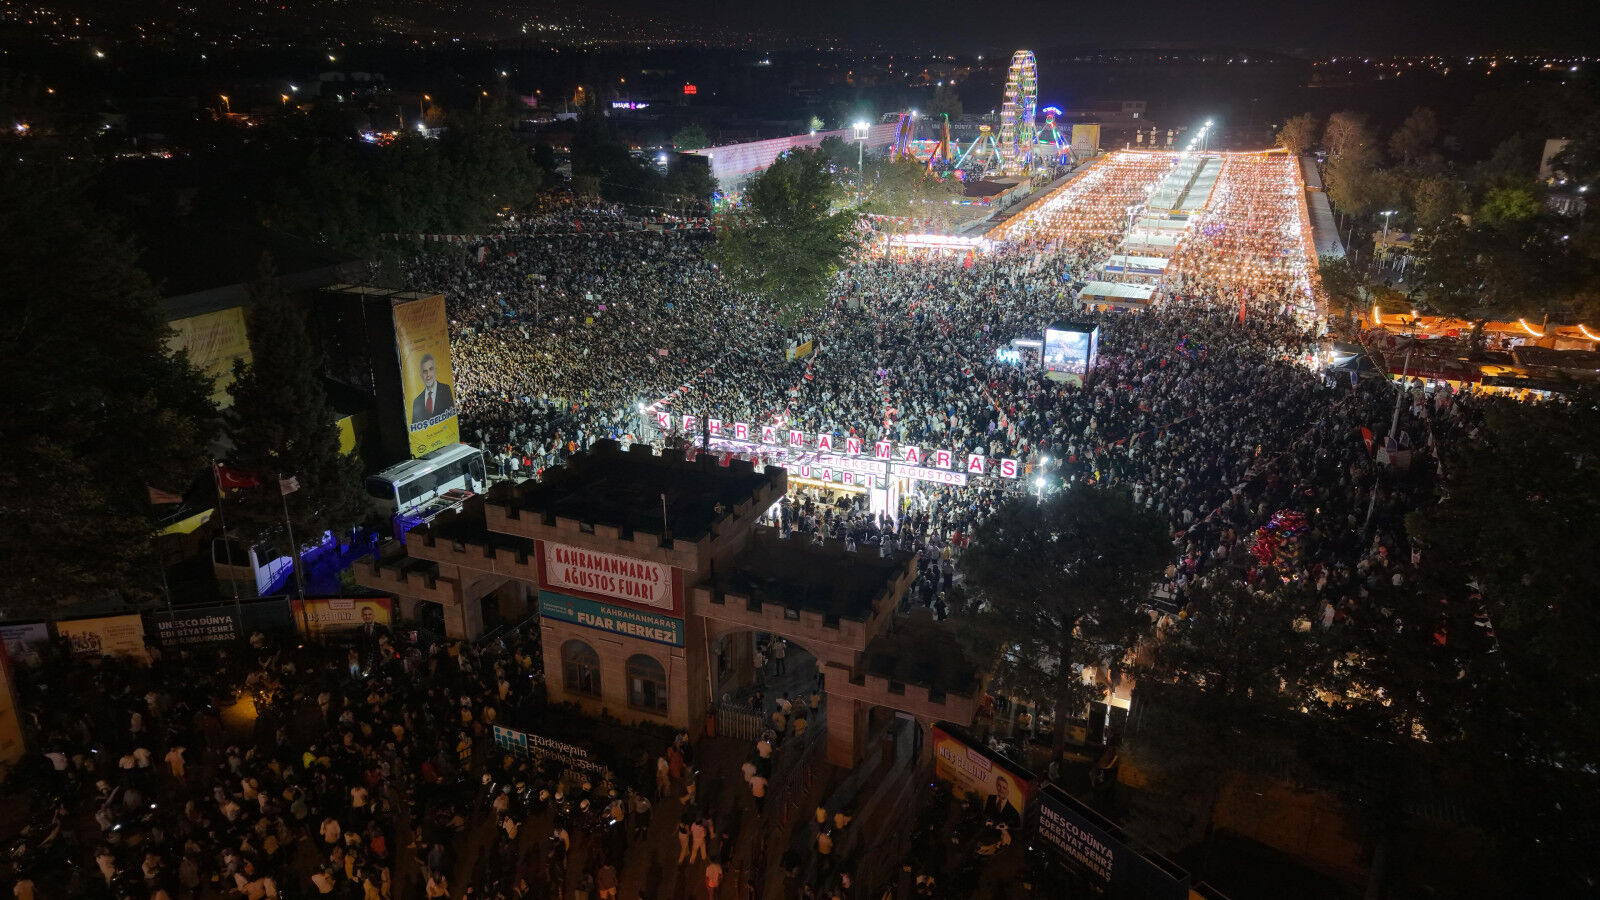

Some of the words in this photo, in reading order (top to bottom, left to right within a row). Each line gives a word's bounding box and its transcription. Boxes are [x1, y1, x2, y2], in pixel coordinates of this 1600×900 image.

[410, 419, 429, 432] HOŞ
[555, 548, 659, 585] KAHRAMANMARAŞ
[564, 567, 616, 592] AĞUSTOS
[618, 579, 654, 600] FUARI
[159, 627, 204, 639] EDBİYAT
[199, 615, 233, 627] DÜNYA
[304, 613, 319, 623] OŞ
[577, 612, 614, 630] FUAR
[616, 620, 677, 644] MERKEZİ
[600, 606, 677, 630] KAHRAMANMARAŞ
[1039, 816, 1083, 850] EDEBİYAT
[1084, 846, 1113, 872] ŞEHRİ
[1040, 804, 1079, 835] UNESCO
[1080, 830, 1113, 860] DÜNYA
[1039, 826, 1112, 882] KAHRAMANMARAŞ
